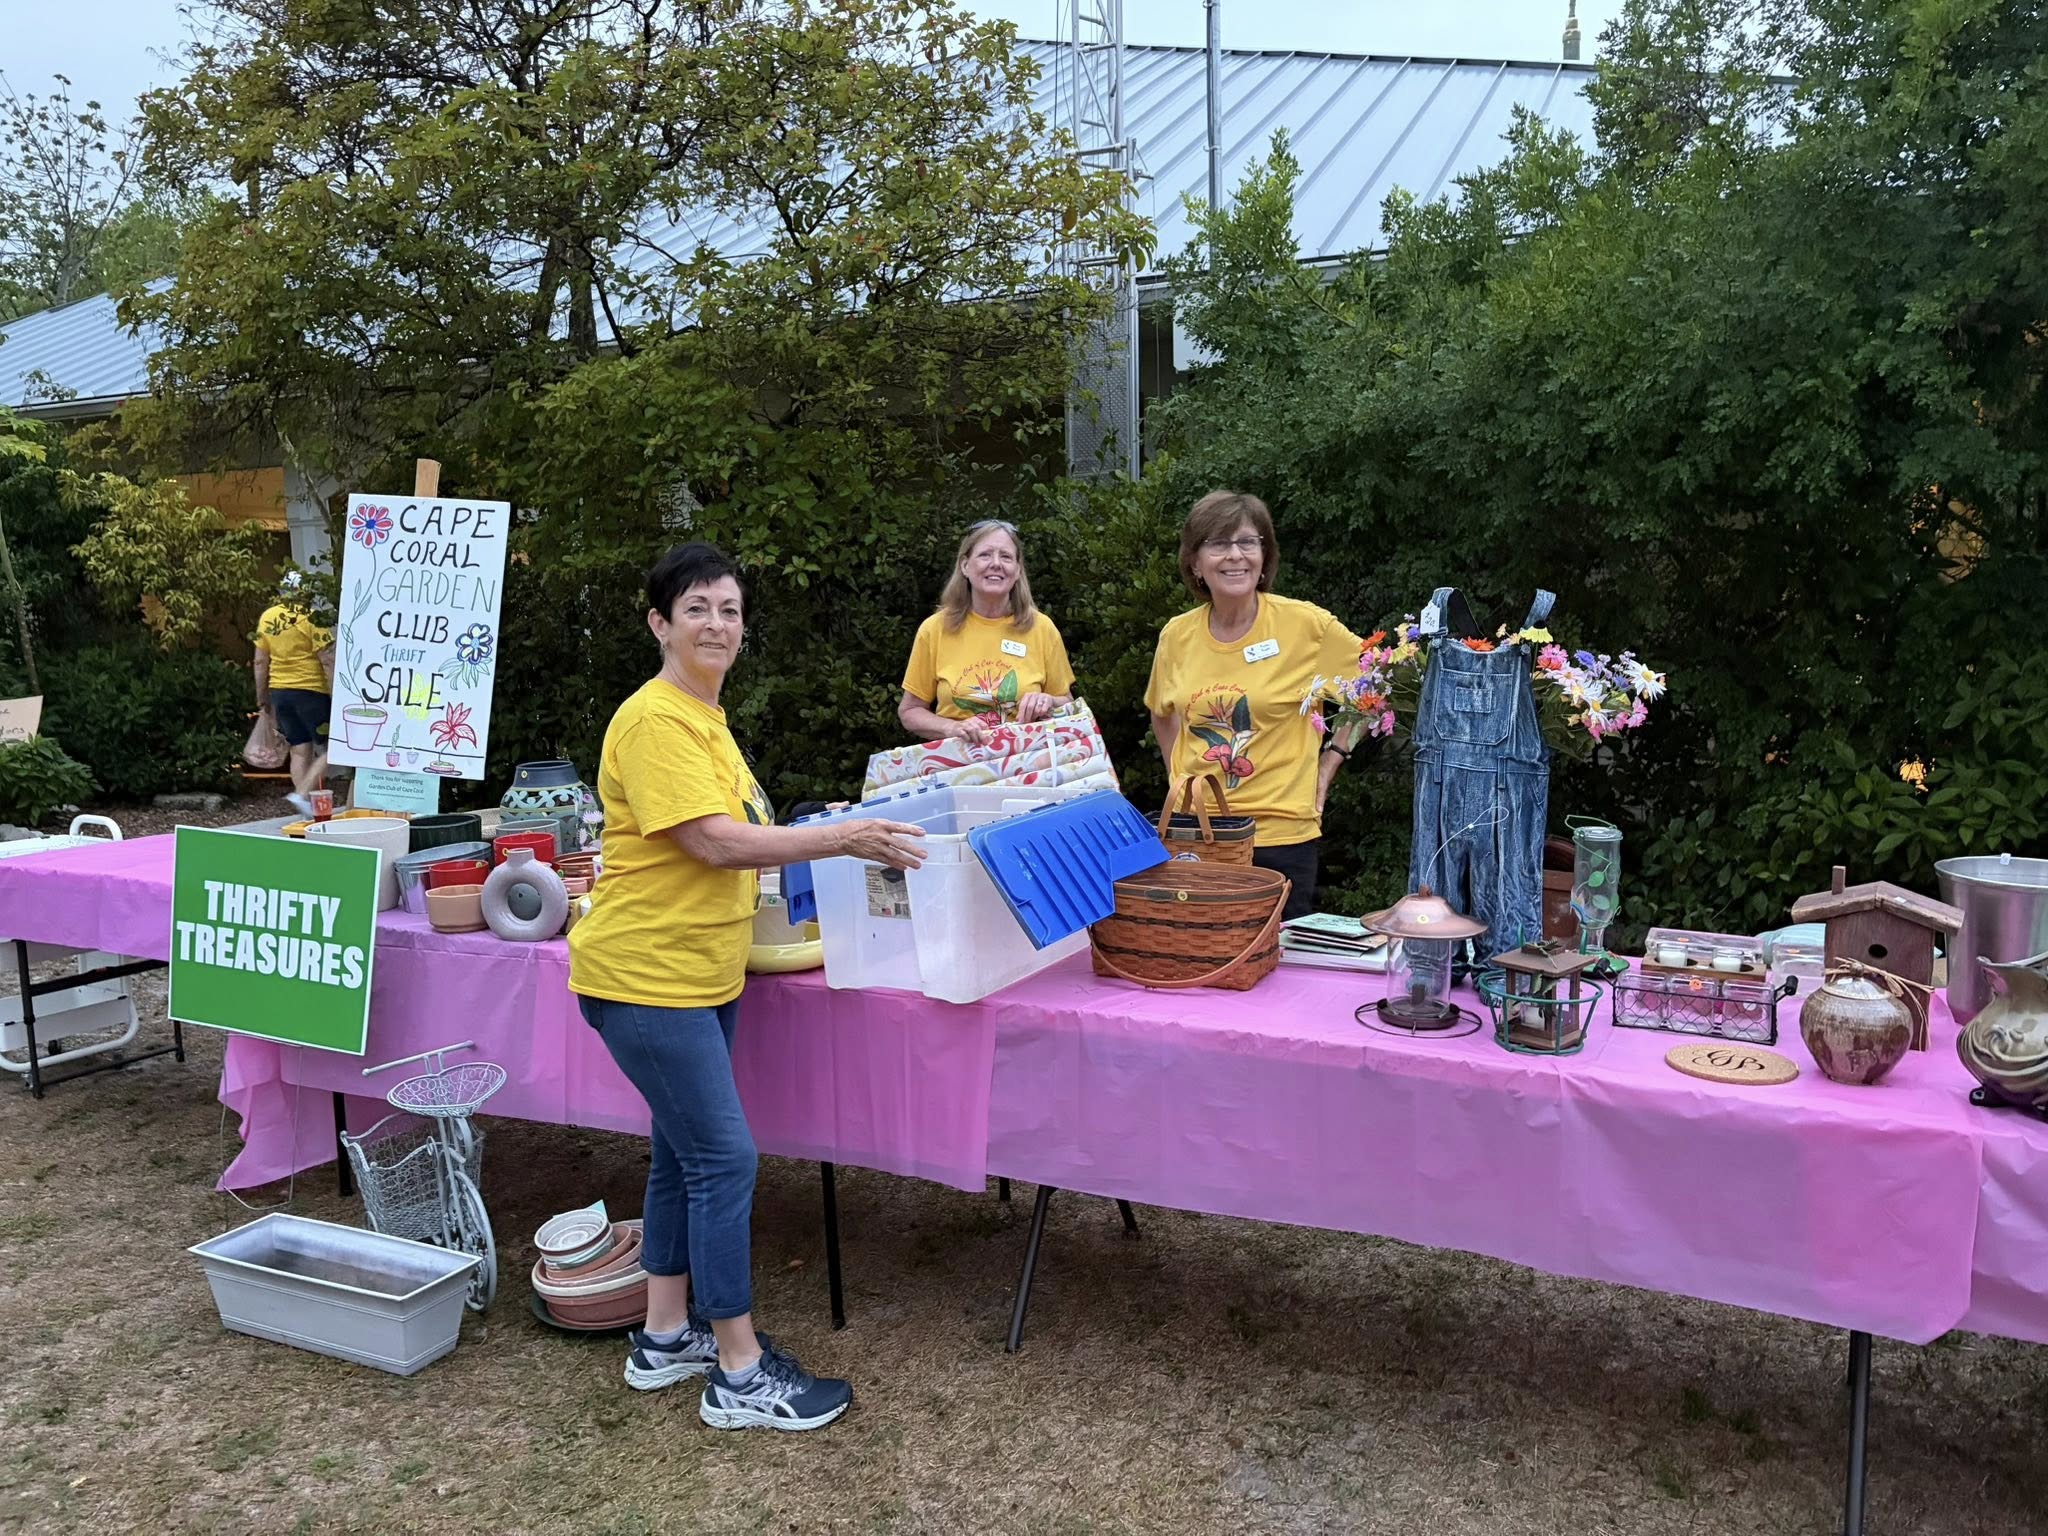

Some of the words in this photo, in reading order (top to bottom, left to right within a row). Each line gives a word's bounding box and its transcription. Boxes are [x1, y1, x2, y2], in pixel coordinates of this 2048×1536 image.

[399, 504, 496, 539] CAPE
[389, 539, 480, 569] CORAL
[376, 566, 496, 613] GARDEN
[377, 610, 449, 644] CLUB
[380, 643, 427, 664] THRIFT
[361, 662, 445, 711] SALE
[203, 879, 342, 938] THRIFTY
[176, 920, 365, 990] TREASURES
